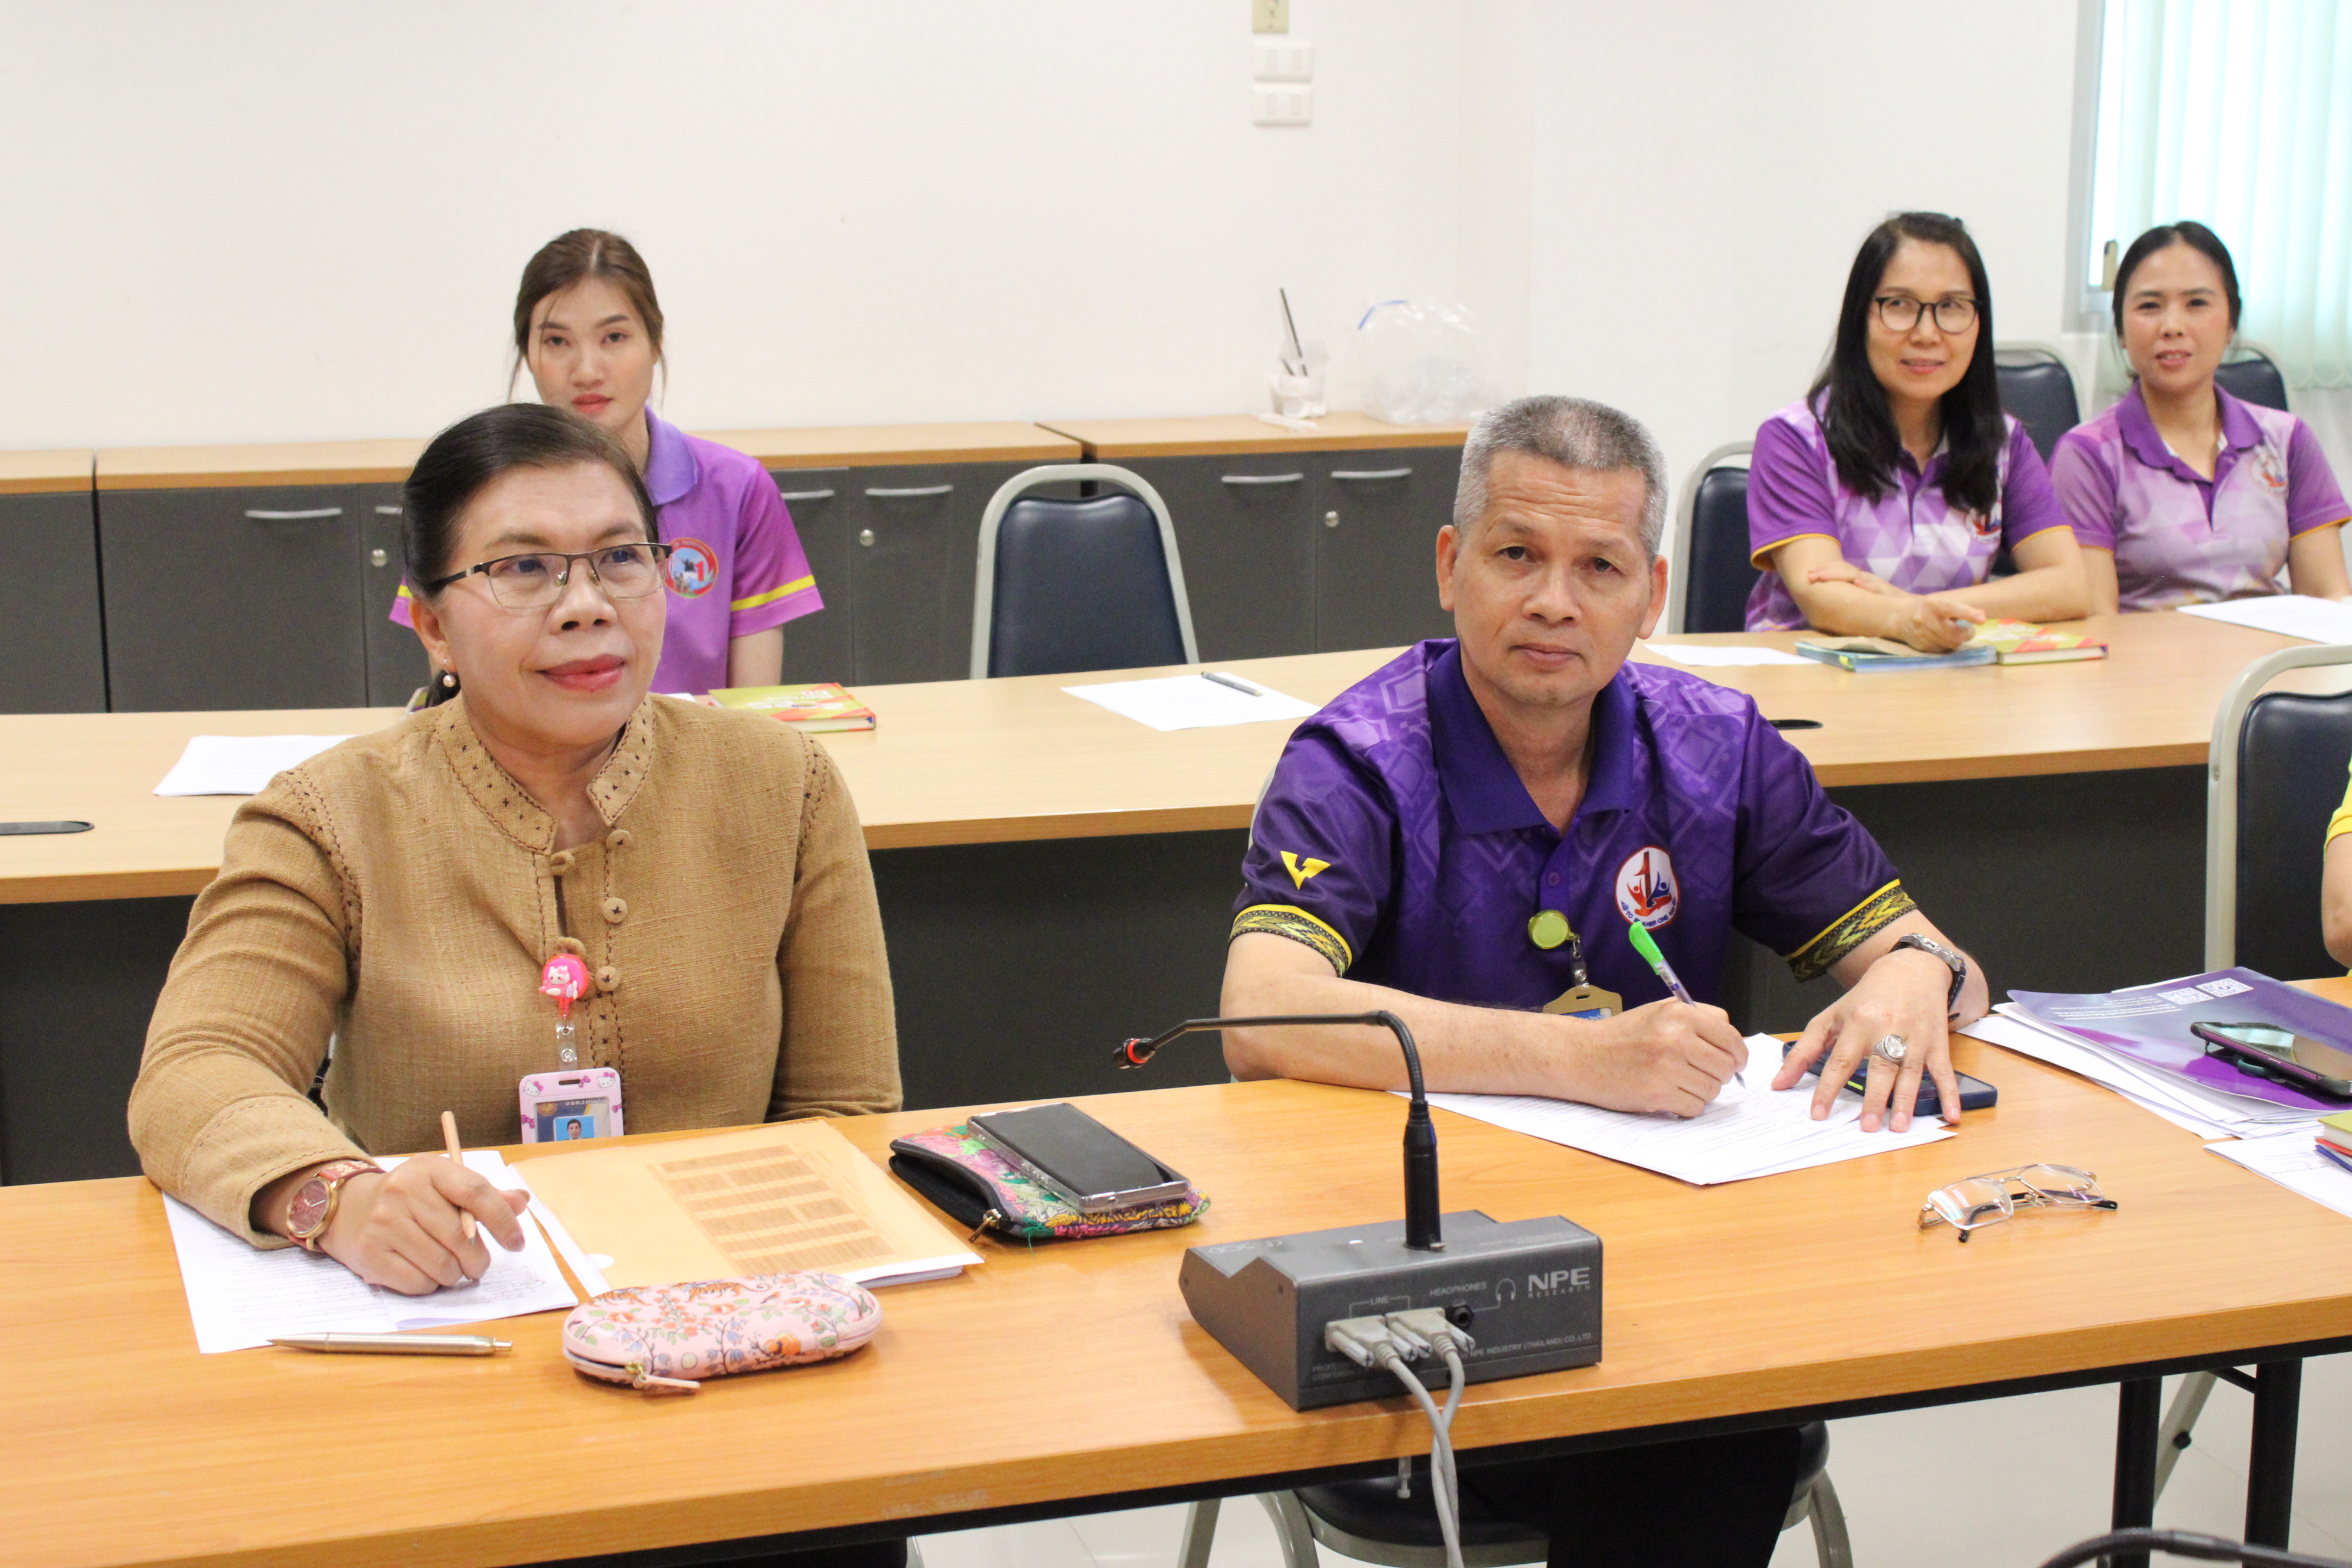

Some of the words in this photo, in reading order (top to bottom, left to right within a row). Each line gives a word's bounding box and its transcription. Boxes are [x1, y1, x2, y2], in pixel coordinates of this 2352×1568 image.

[1626, 910, 1634, 919] TO
[1657, 914, 1670, 924] ONE
[1528, 1267, 1590, 1292] NPE
[1429, 1281, 1487, 1297] HEADPHONES
[1370, 1296, 1389, 1305] LINE
[1486, 1344, 1523, 1355] INDUSTRY
[1524, 1337, 1563, 1350] (THAILAND)
